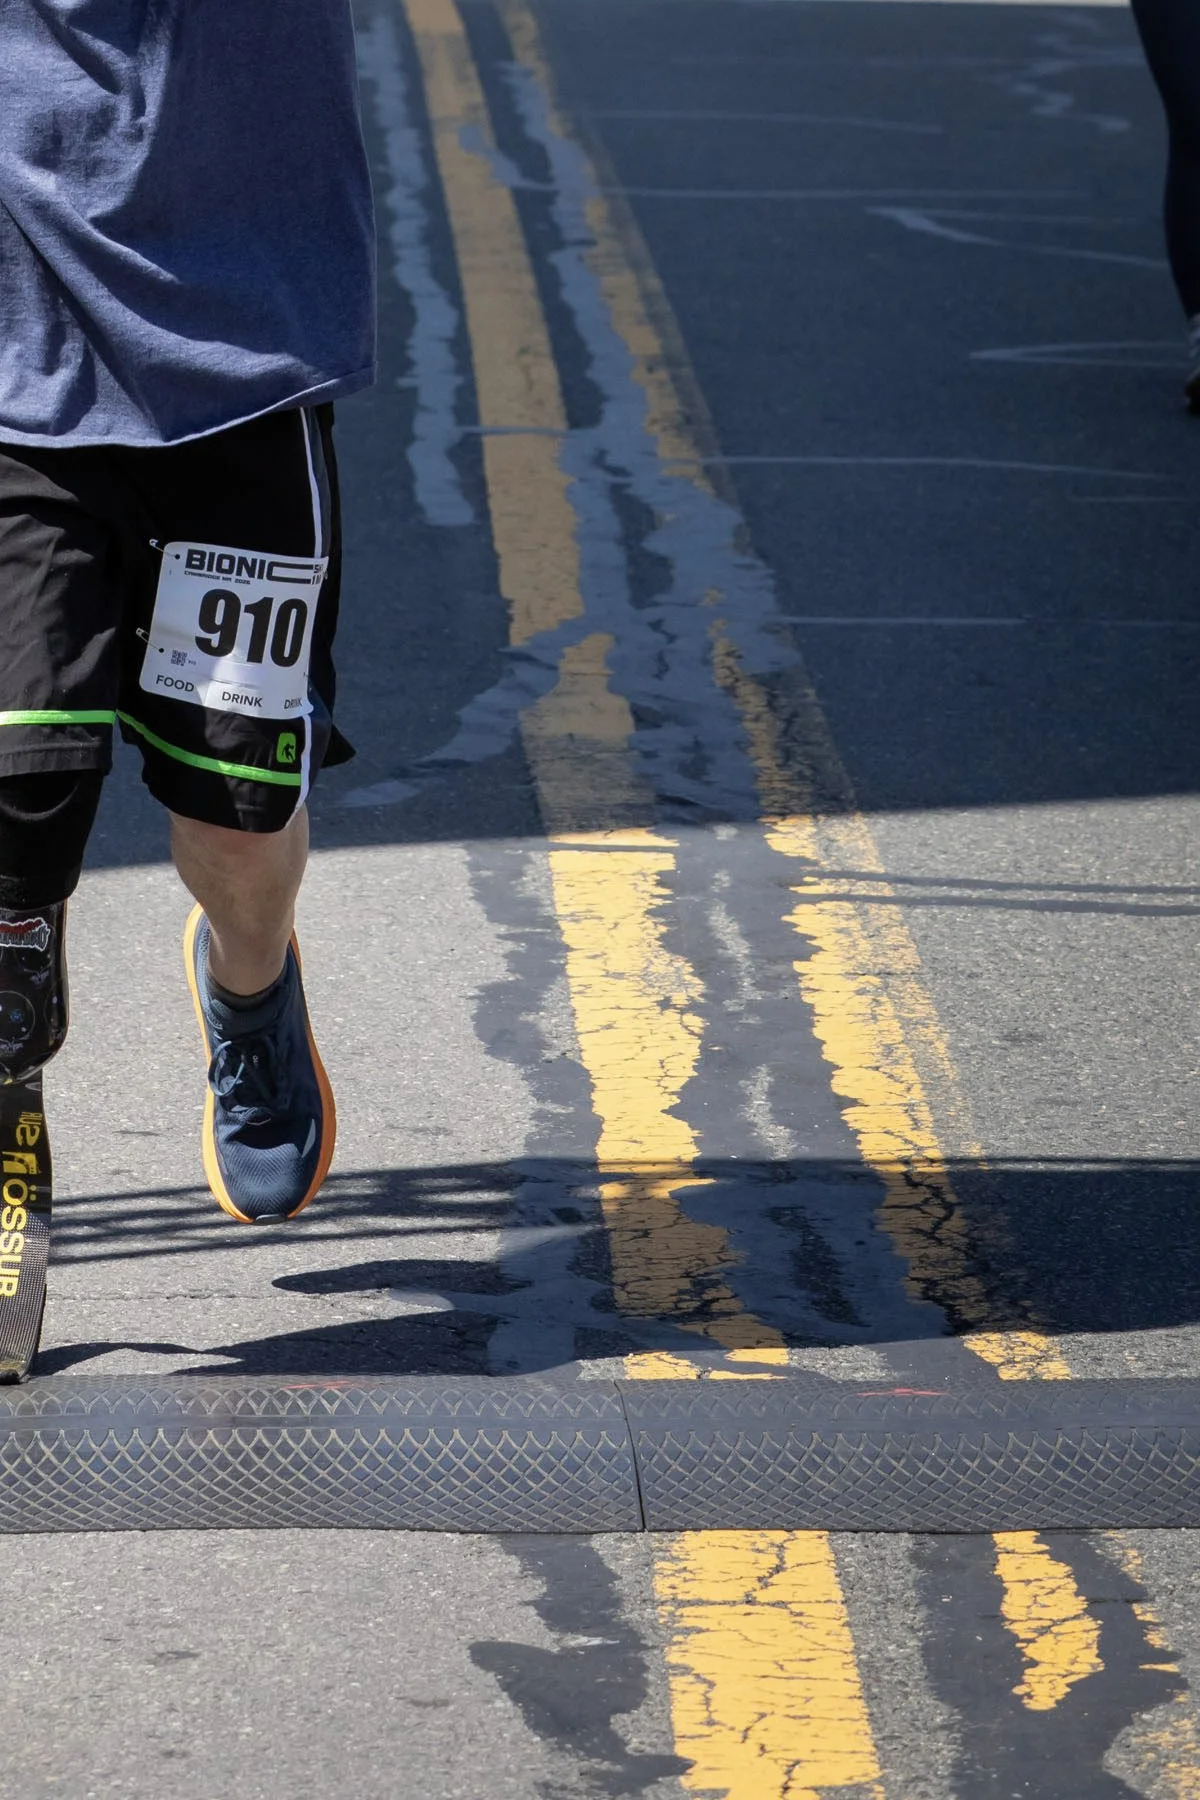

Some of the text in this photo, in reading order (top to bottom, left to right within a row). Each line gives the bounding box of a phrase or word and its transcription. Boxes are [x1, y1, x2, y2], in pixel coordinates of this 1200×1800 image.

[185, 549, 314, 584] BIONIC
[195, 588, 308, 667] 910
[155, 674, 195, 693] FOOD
[221, 691, 263, 708] DRINK
